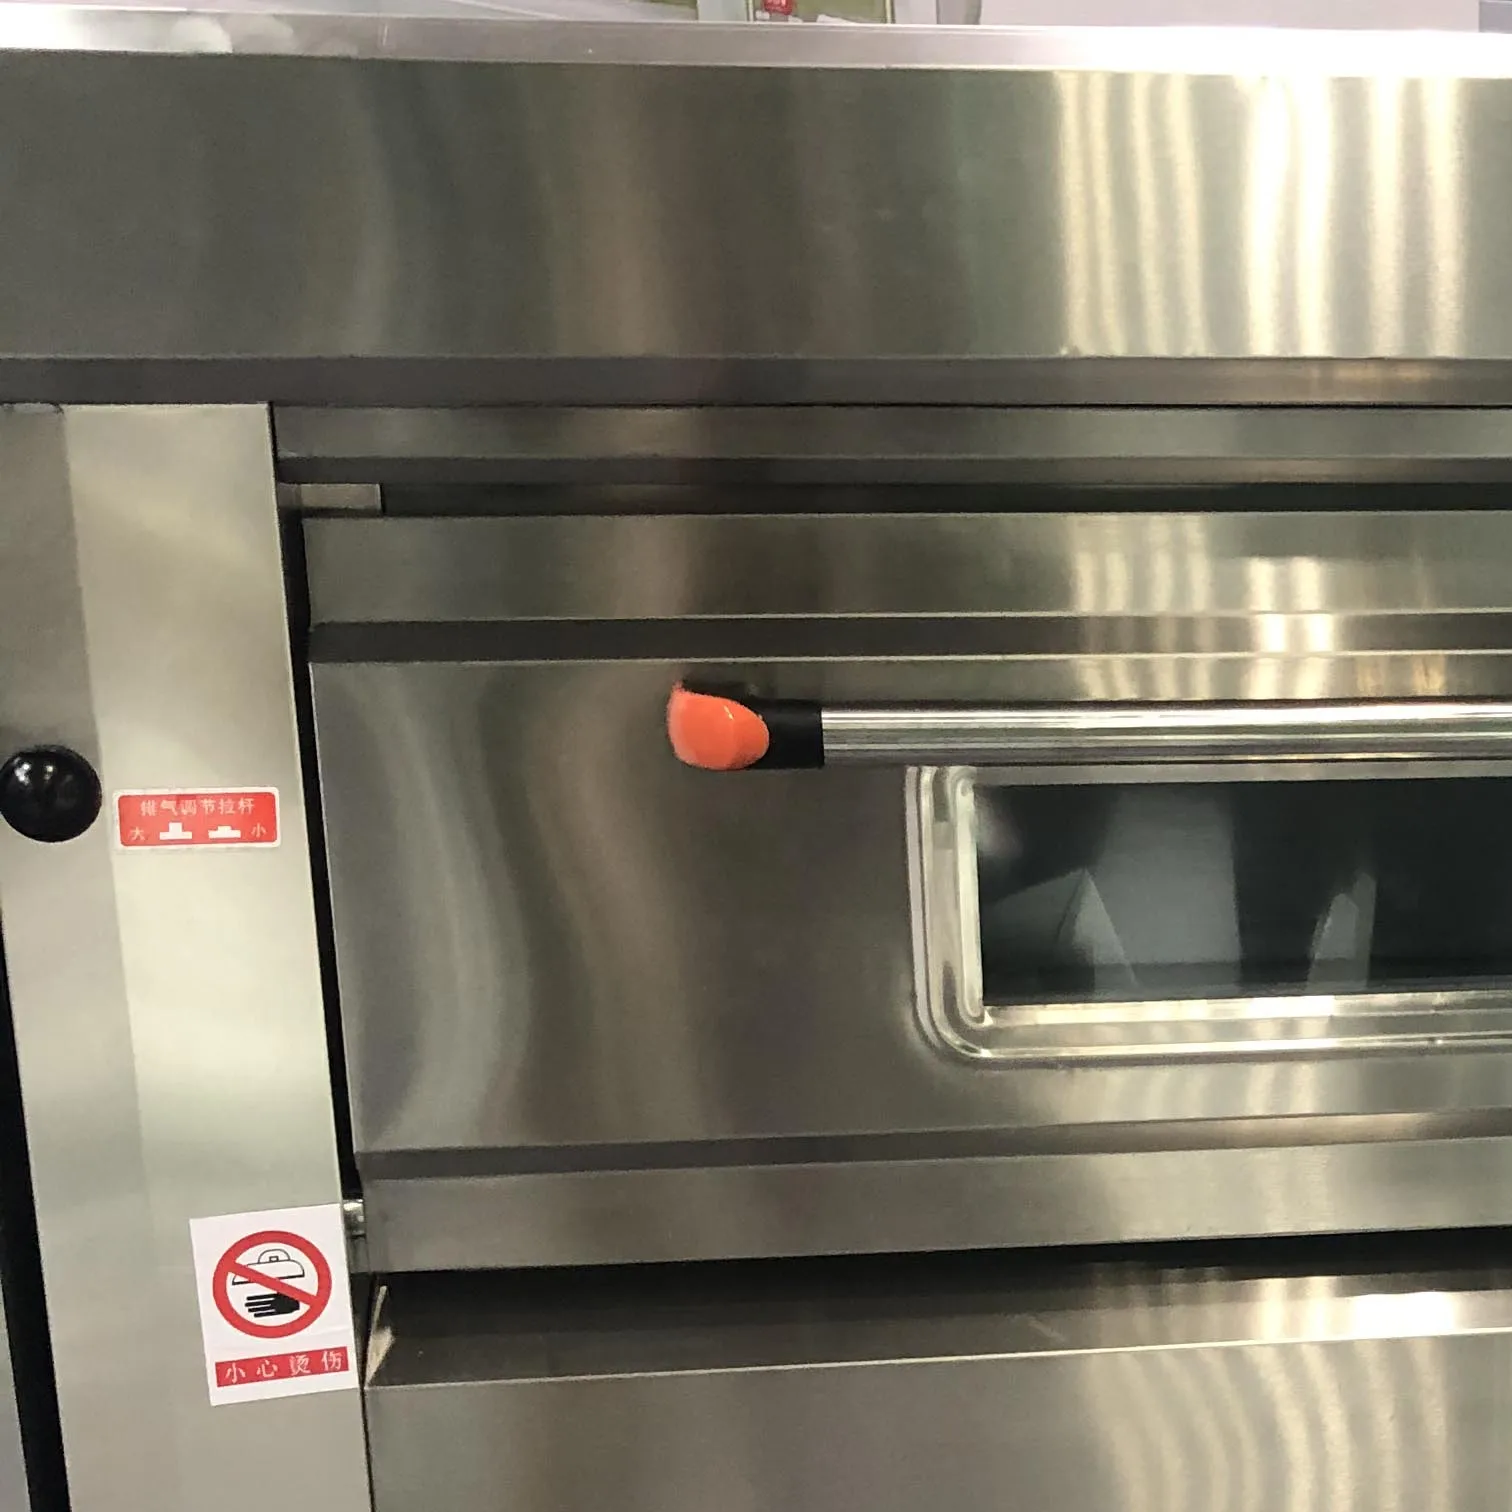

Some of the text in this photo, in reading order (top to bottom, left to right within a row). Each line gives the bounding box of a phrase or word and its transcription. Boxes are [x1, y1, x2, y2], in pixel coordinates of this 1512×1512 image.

[129, 823, 266, 841] 大 小
[224, 1350, 343, 1384] 小心烫伤
